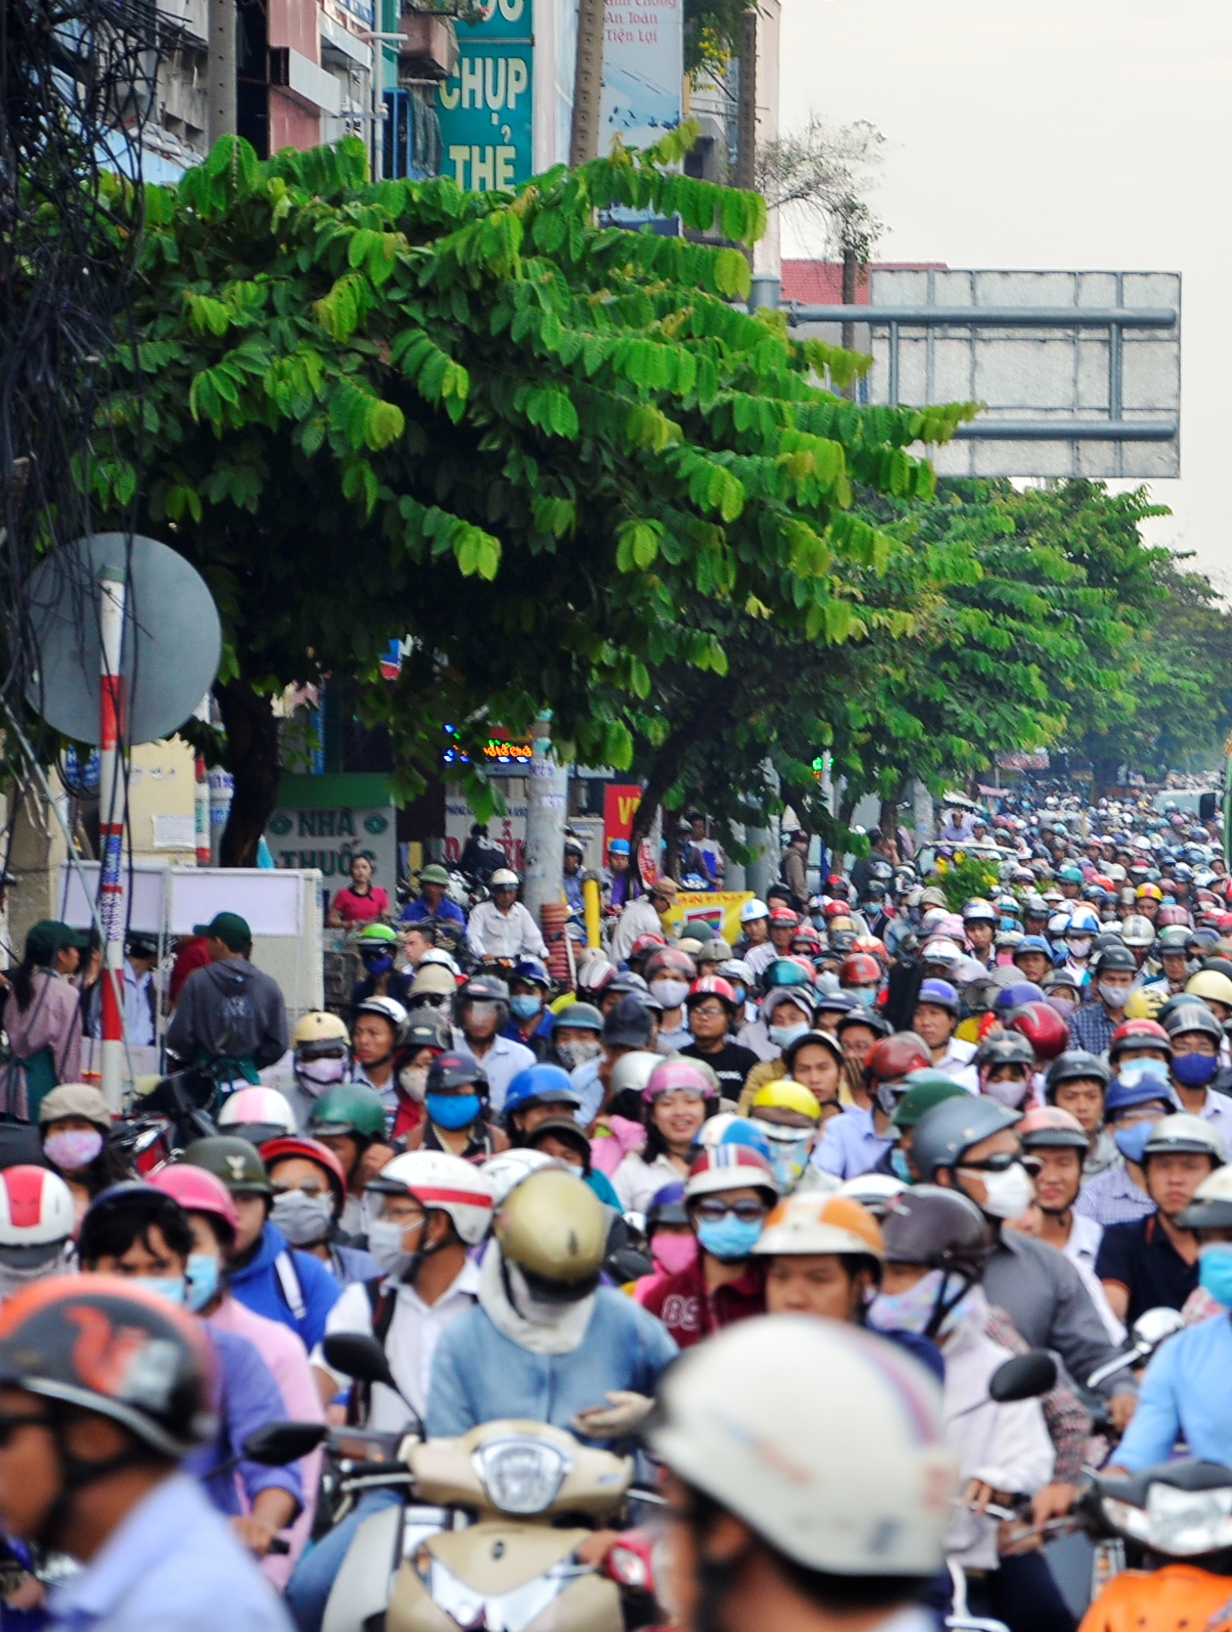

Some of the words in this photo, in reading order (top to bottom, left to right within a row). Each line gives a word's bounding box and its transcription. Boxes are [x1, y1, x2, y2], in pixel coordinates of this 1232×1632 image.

[604, 12, 623, 24] An
[606, 28, 633, 44] Tiện
[439, 57, 528, 126] CHỤP
[449, 124, 516, 196] THẺ
[297, 807, 358, 837] NHÀ
